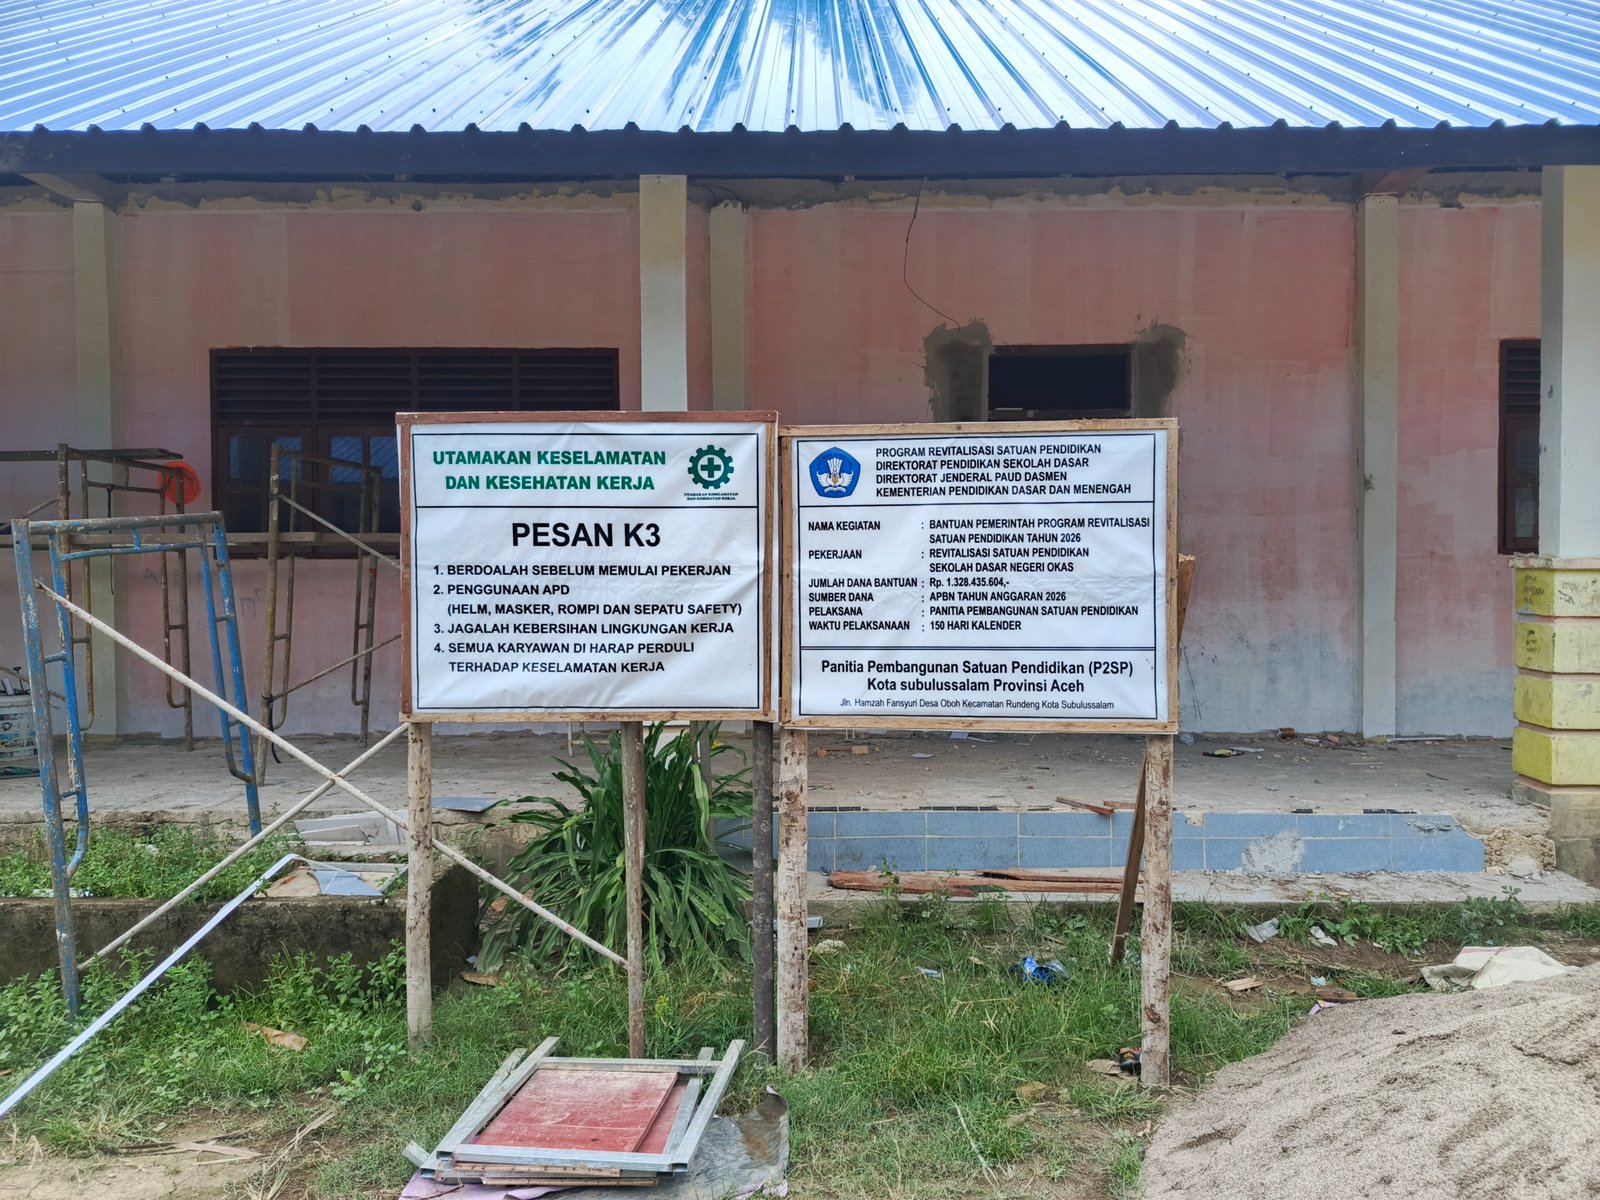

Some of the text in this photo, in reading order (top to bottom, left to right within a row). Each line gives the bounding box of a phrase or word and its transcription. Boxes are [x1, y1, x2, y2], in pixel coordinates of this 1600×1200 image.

[876, 444, 1101, 457] PROGRAM REVITALISASI SATUAN PENDIDIKAN
[433, 451, 665, 465] UTAMAKAN KESELAMATAN
[876, 458, 1089, 470] DIREKTORAT PENDIDIKAN SEKOLAH DASAR
[446, 476, 654, 490] DAN KESEHATAN KERJA
[876, 472, 1066, 484] DIREKTORAT JENDERAL PAUD DASMEN
[877, 484, 1131, 497] KEMENTERIAN PENDIDIKAN DASAR DAN MENENGAH
[809, 522, 834, 531] NAMA
[836, 521, 880, 530] KEGIATAN
[930, 520, 973, 529] BANTUAN
[976, 519, 1034, 528] PEMERINTAH
[1038, 518, 1085, 528] PROGRAM
[1088, 518, 1149, 527] REVITALISASI
[512, 523, 660, 547] PESAN K3
[930, 533, 1081, 543] SATUAN PENDIDIKAN TAHUN 2026
[809, 550, 861, 559] PEKERJAAN
[930, 548, 990, 558] REVITALISASI
[993, 548, 1029, 557] SATUAN
[1033, 548, 1089, 557] PENDIDIKAN
[434, 565, 730, 575] 1. BERDOALAH SEBELUM MEMULAI PEKERJAN
[930, 562, 1073, 572] SEKOLAH DASAR NEGERI OKAS
[809, 579, 844, 587] JUMLAH
[847, 578, 872, 587] DANA
[875, 578, 917, 587] BANTUAN
[930, 578, 944, 588] Rp.
[947, 577, 1009, 587] 1.328.435.604,-
[434, 585, 569, 595] 2. PENGGUNAAN APD
[809, 593, 846, 602] SUMBER
[849, 593, 874, 601] DANA
[930, 592, 954, 601] APBN
[957, 592, 988, 601] TAHUN
[990, 592, 1043, 601] ANGGARAN
[1046, 592, 1066, 601] 2026
[448, 603, 741, 616] (HELM, MASKER, ROMPI DAN SEPATU SAFETY)
[809, 607, 863, 616] PELAKSANA
[930, 606, 965, 615] PANITIA
[967, 606, 1038, 615] PEMBANGUNAN
[1041, 606, 1078, 615] SATUAN
[1080, 606, 1138, 615] PENDIDIKAN
[434, 623, 734, 634] 3. JAGALAH KEBERSIHAN LINGKUNGAN KERJA
[809, 621, 840, 630] WAKTU
[843, 621, 909, 630] PELAKSANAAN
[931, 621, 945, 630] 150
[948, 621, 969, 630] HARI
[972, 621, 1021, 630] KALENDER
[434, 642, 694, 653] 4. SEMUA KARYAWAN DI HARAP PERDULI
[449, 662, 664, 672] TERHADAP KESELAMATAN KERJA
[822, 660, 1133, 677] Panitia Pembangunan Satuan Pendidikan (P2SP)
[868, 678, 1084, 692] Kota subulussalam Provinsi Aceh
[855, 699, 884, 707] Hamzah
[887, 699, 917, 709] Fansyuri
[920, 699, 938, 707] Desa
[941, 699, 960, 707] Oboh
[963, 700, 1004, 708] Kecamatan
[1006, 700, 1039, 710] Rundeng
[1042, 700, 1059, 708] Kota
[1062, 700, 1114, 709] Subulussalam
